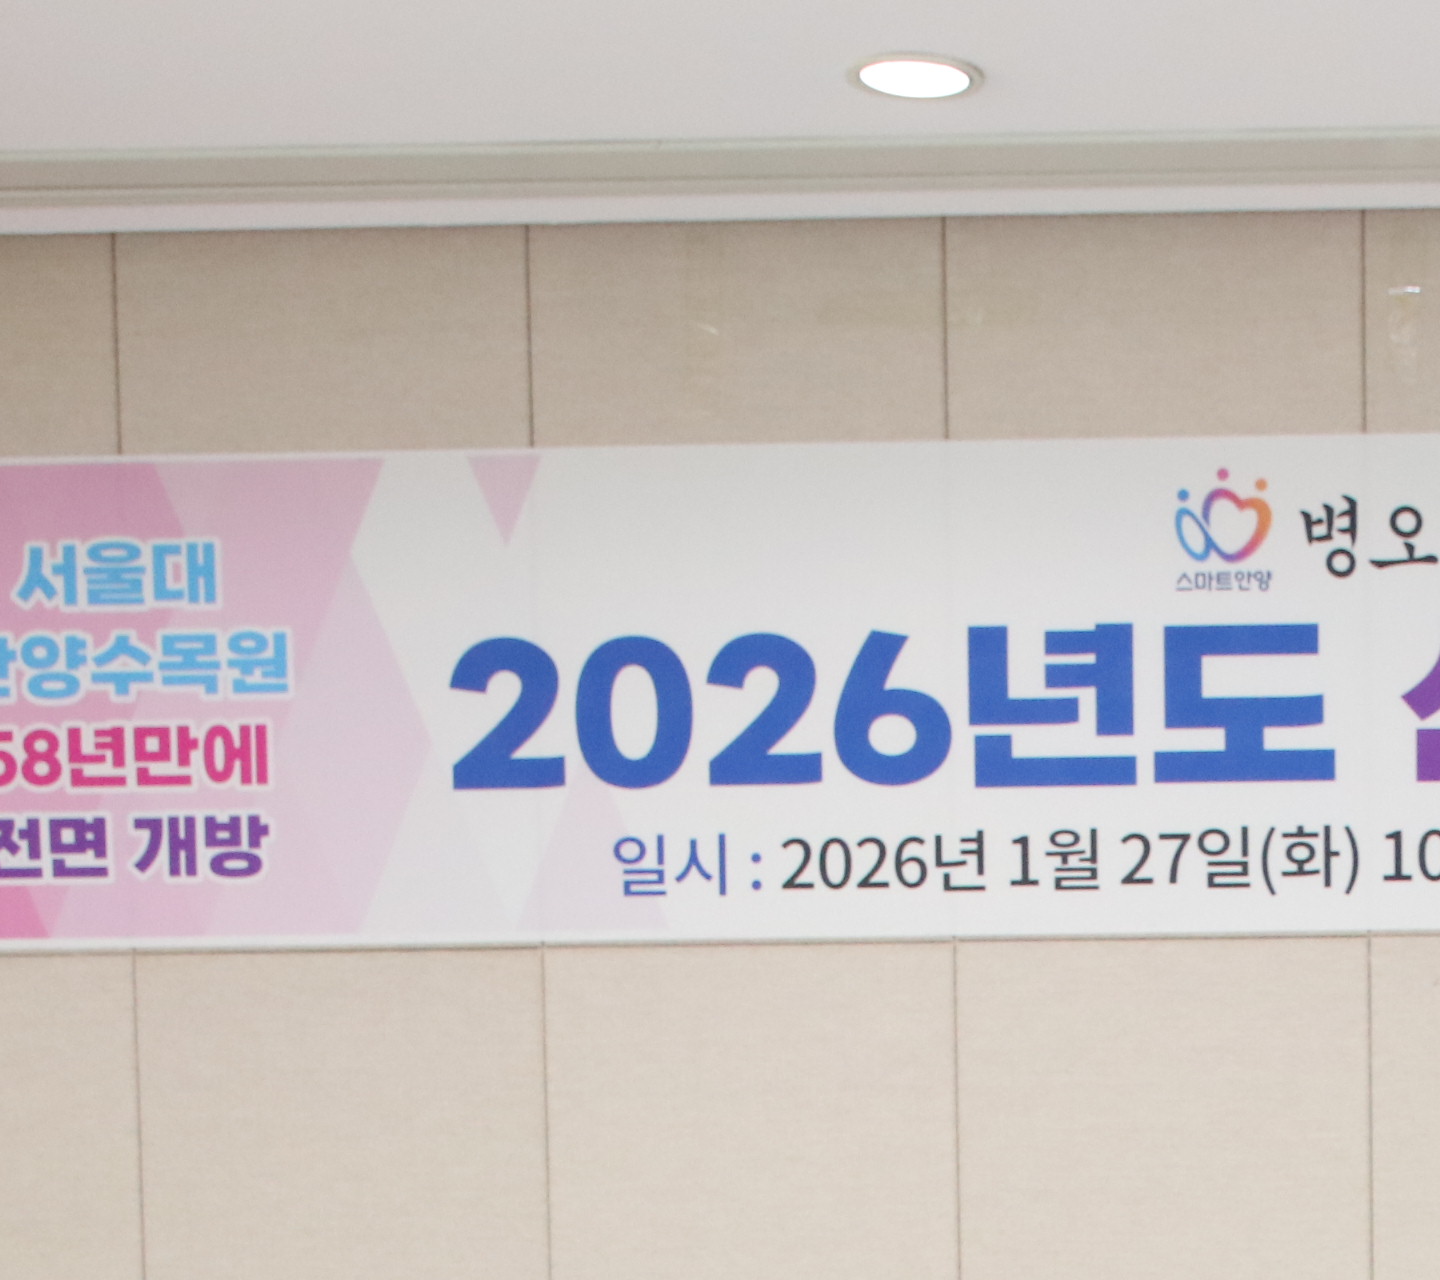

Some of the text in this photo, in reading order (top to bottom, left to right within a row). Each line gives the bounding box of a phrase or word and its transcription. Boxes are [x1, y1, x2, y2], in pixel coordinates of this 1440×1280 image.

[16, 541, 217, 606] 서울대
[1178, 571, 1271, 591] 스마트안양
[450, 623, 1335, 789] 2026년도
[134, 815, 270, 877] 개방
[782, 830, 985, 891] 2026년
[1011, 828, 1099, 890] 1월
[1121, 825, 1358, 895] 27일(화)
